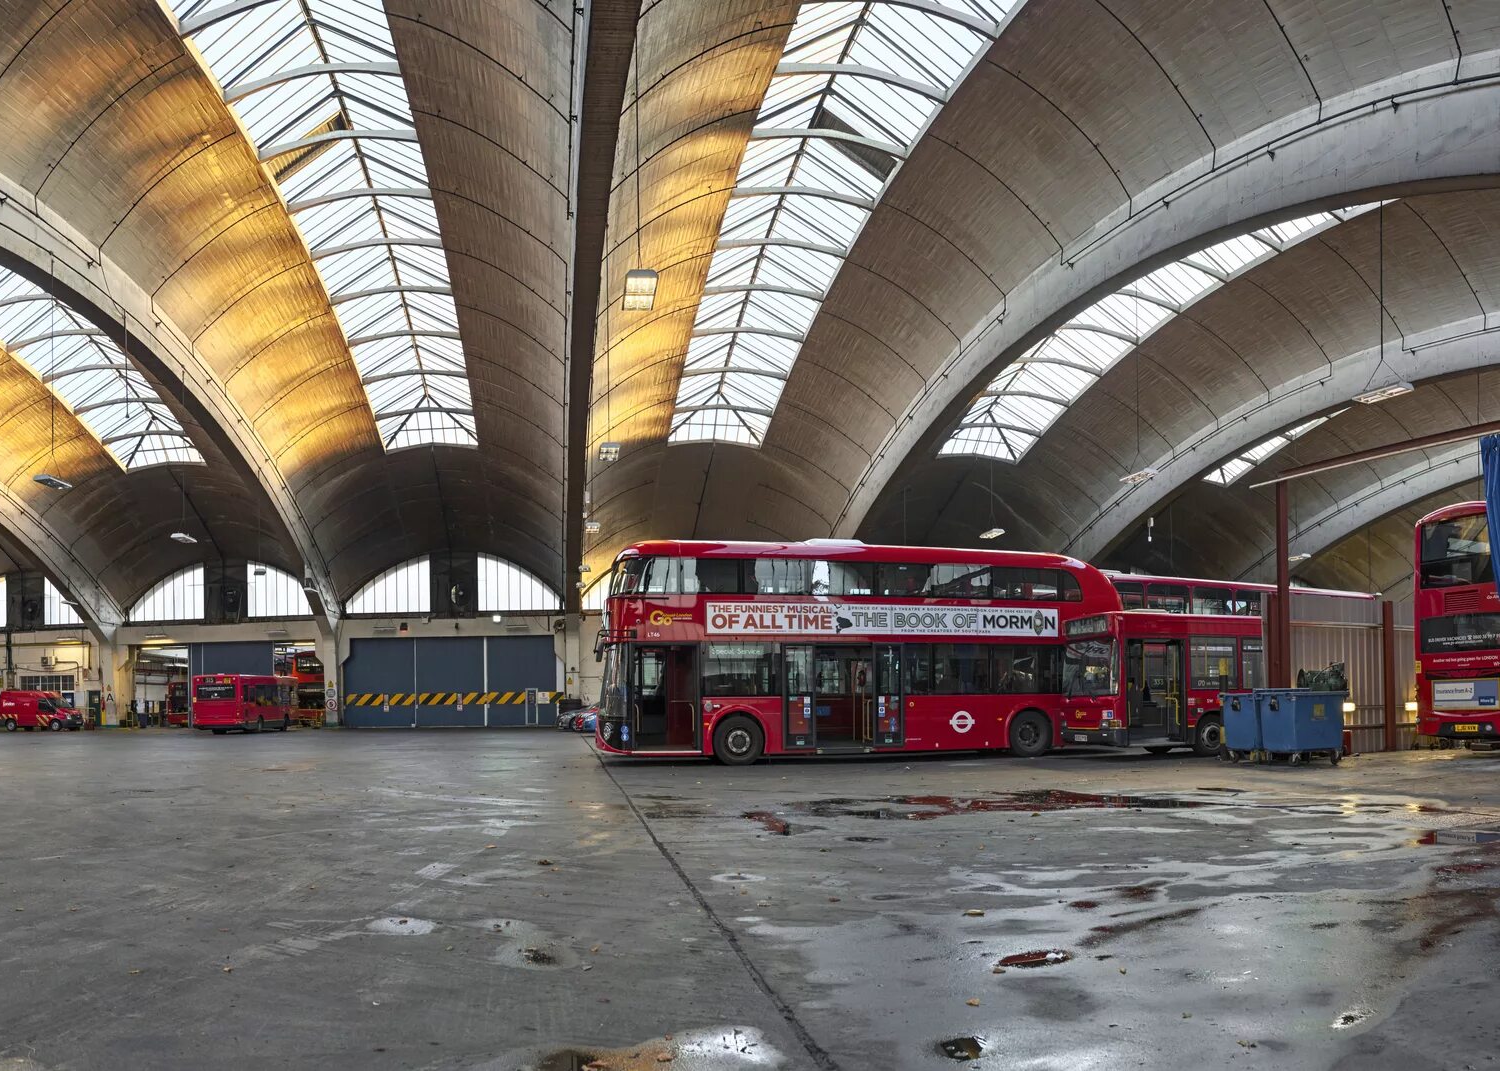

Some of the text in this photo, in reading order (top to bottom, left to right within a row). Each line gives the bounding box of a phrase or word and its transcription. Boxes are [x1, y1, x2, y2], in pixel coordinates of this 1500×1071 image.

[650, 609, 672, 626] Go
[734, 605, 785, 613] FUNNIEST
[787, 605, 832, 614] MUSICAL
[711, 614, 833, 630] OF ALL TIME
[851, 611, 1056, 633] THE BOOK OF MORMON
